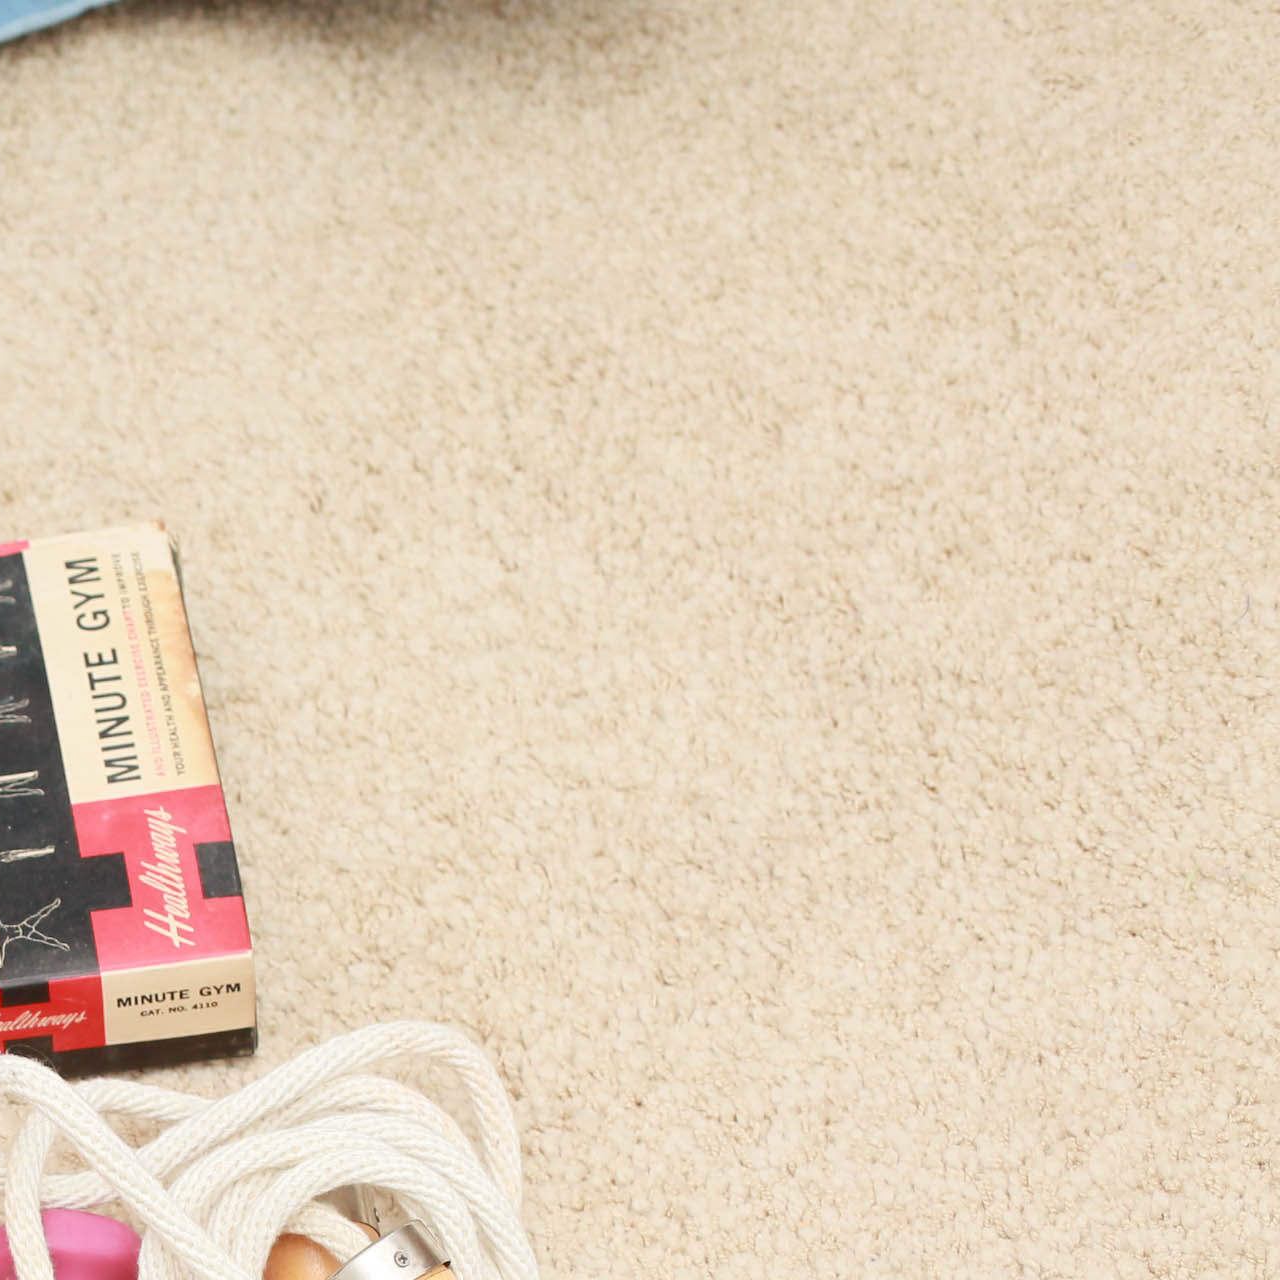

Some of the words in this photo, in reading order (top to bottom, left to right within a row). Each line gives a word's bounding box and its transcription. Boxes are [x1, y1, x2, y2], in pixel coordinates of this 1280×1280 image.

[65, 557, 110, 631] GYM
[141, 595, 156, 635] THROUGH
[149, 639, 169, 691] APPEARANCE
[83, 648, 142, 784] MINUTE
[161, 694, 172, 712] AND
[165, 714, 180, 750] HEALTH
[172, 751, 186, 776] YOUR
[139, 806, 196, 948] Healthways
[116, 989, 190, 1008] MINUTE
[199, 983, 241, 998] GYM
[140, 1009, 164, 1017] CAT.
[168, 1006, 187, 1014] NO.
[192, 1001, 218, 1010] 4110
